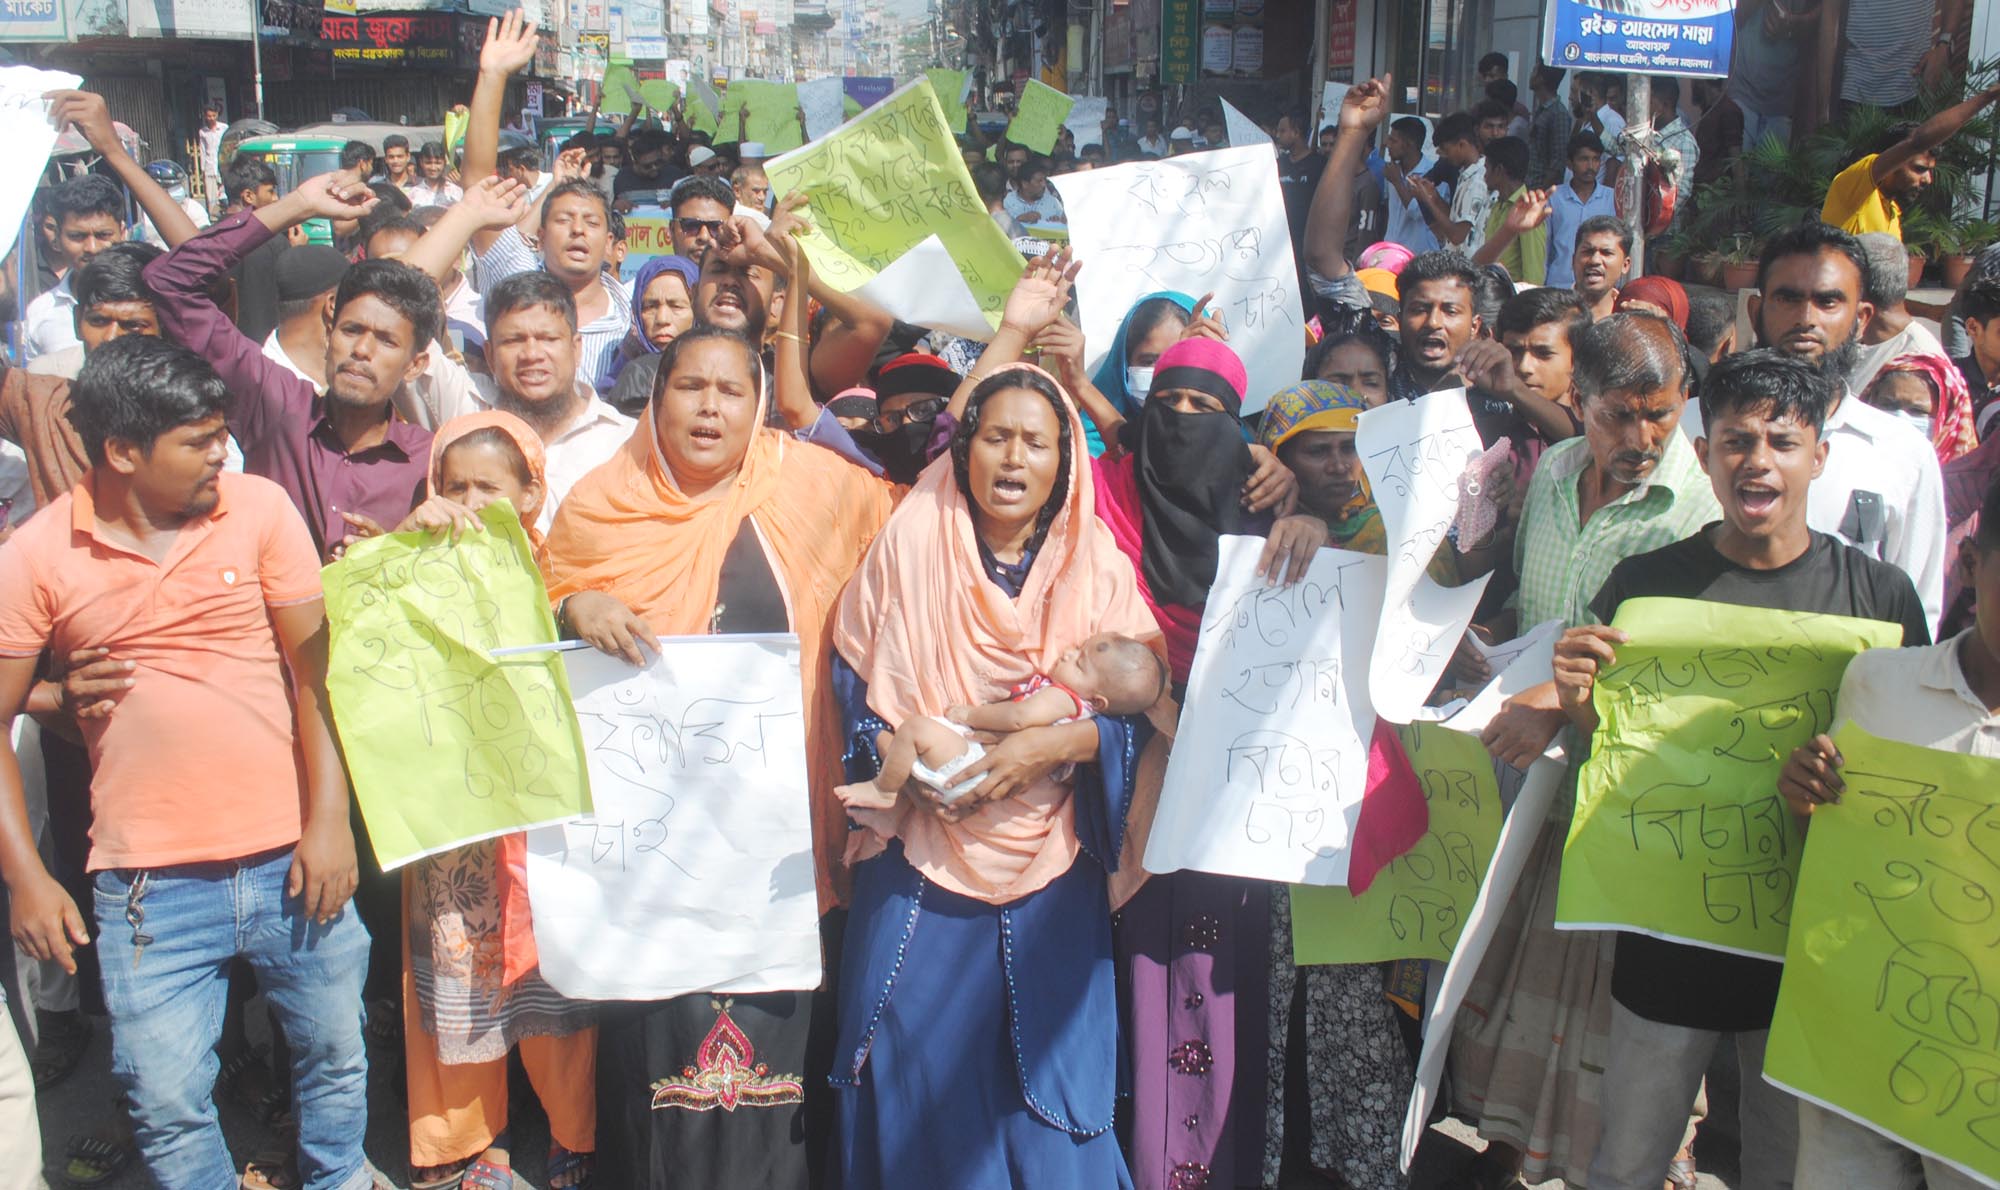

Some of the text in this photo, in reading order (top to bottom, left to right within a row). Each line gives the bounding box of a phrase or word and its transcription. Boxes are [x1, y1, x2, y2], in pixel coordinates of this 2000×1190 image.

[1579, 13, 1714, 46] রইজ আহমেদ মান্না
